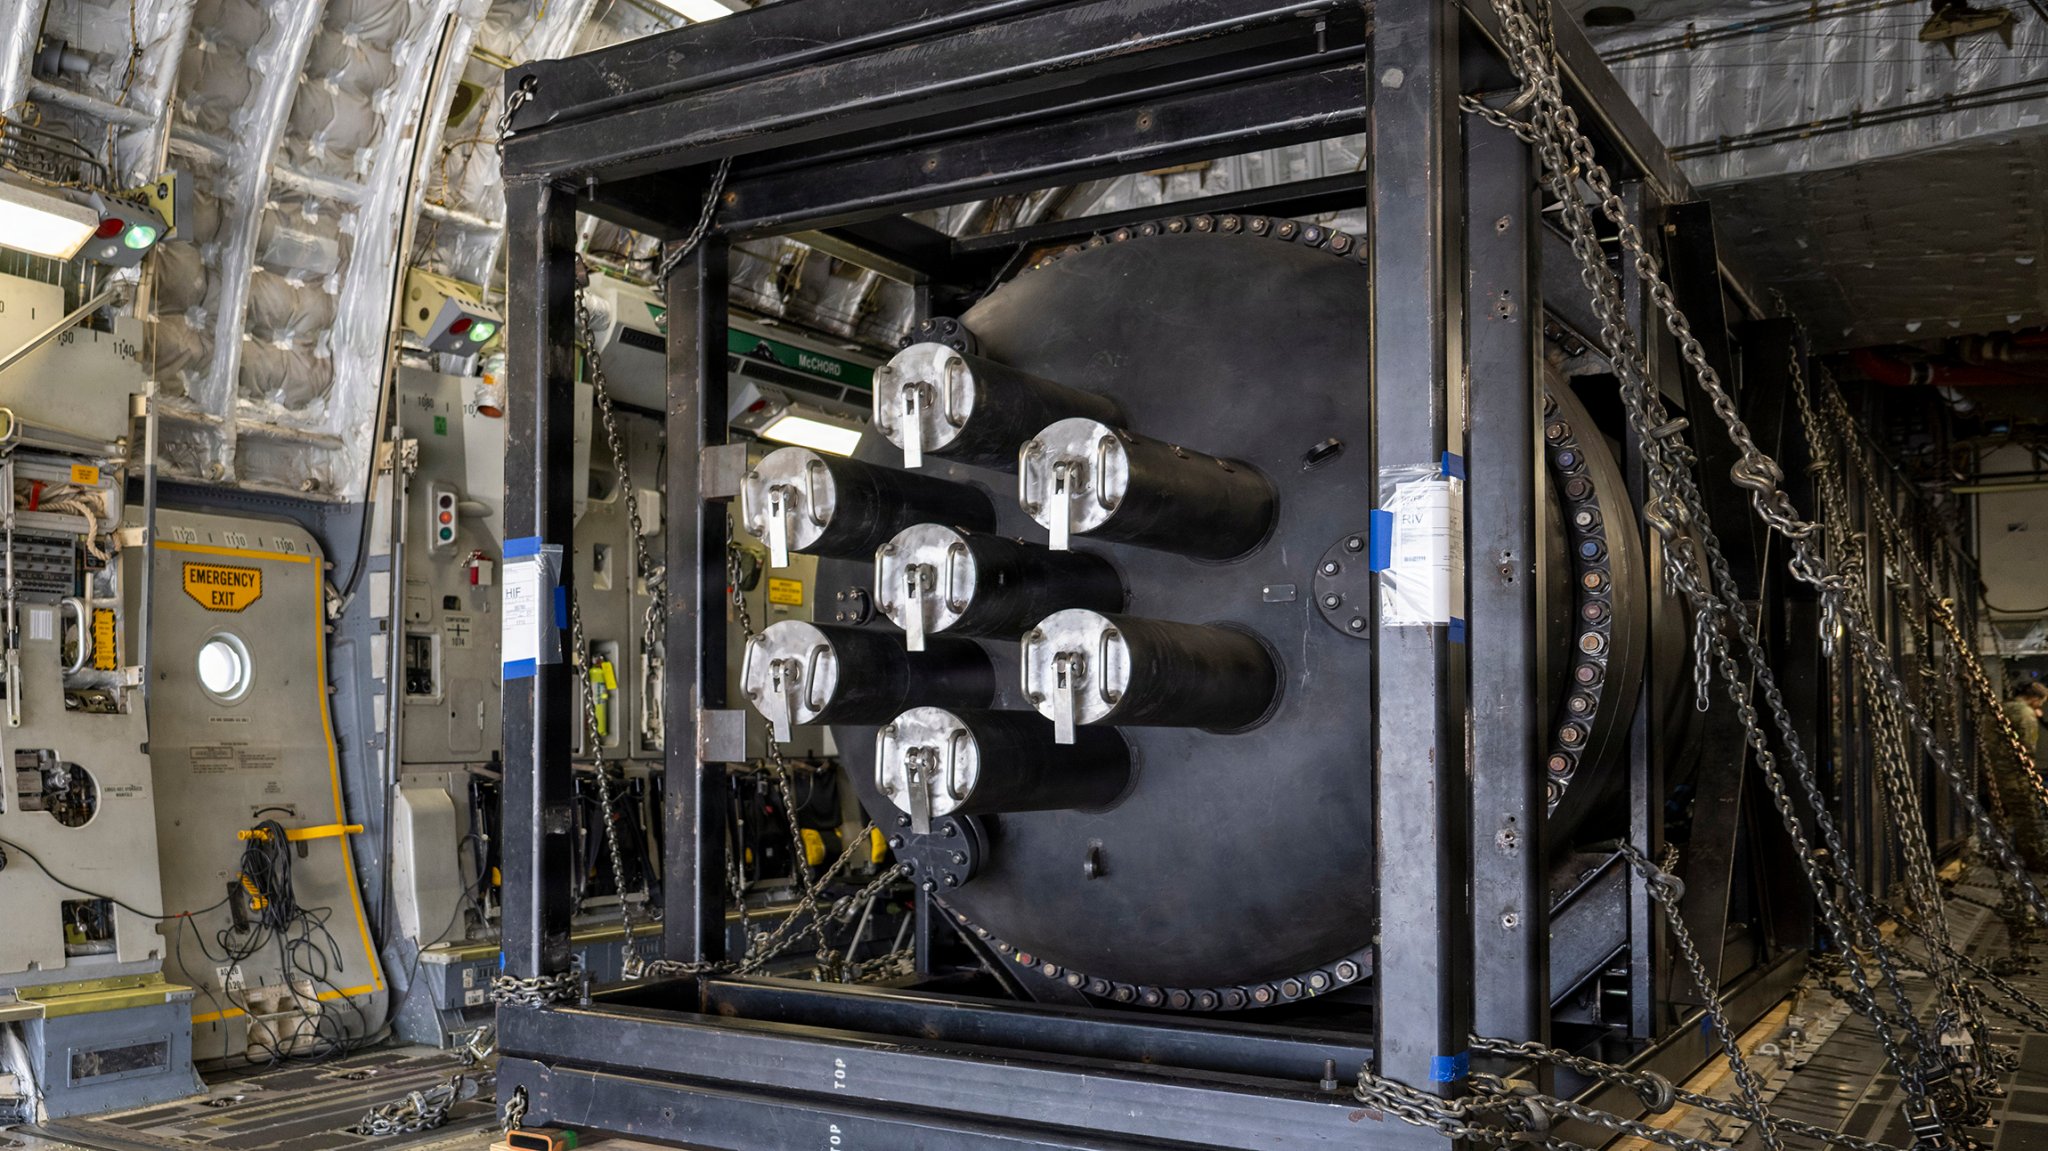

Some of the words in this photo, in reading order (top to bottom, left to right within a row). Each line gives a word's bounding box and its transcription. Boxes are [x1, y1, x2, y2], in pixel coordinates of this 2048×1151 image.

[113, 342, 135, 357] 1140
[798, 354, 841, 375] McCHORD
[1402, 514, 1424, 524] RIV
[174, 530, 196, 542] 1120
[226, 535, 246, 547] 1110
[275, 540, 294, 552] 1100
[190, 569, 255, 588] EMERGENCY
[212, 590, 235, 606] EXIT
[505, 587, 521, 599] HIF
[834, 1058, 846, 1089] TOP
